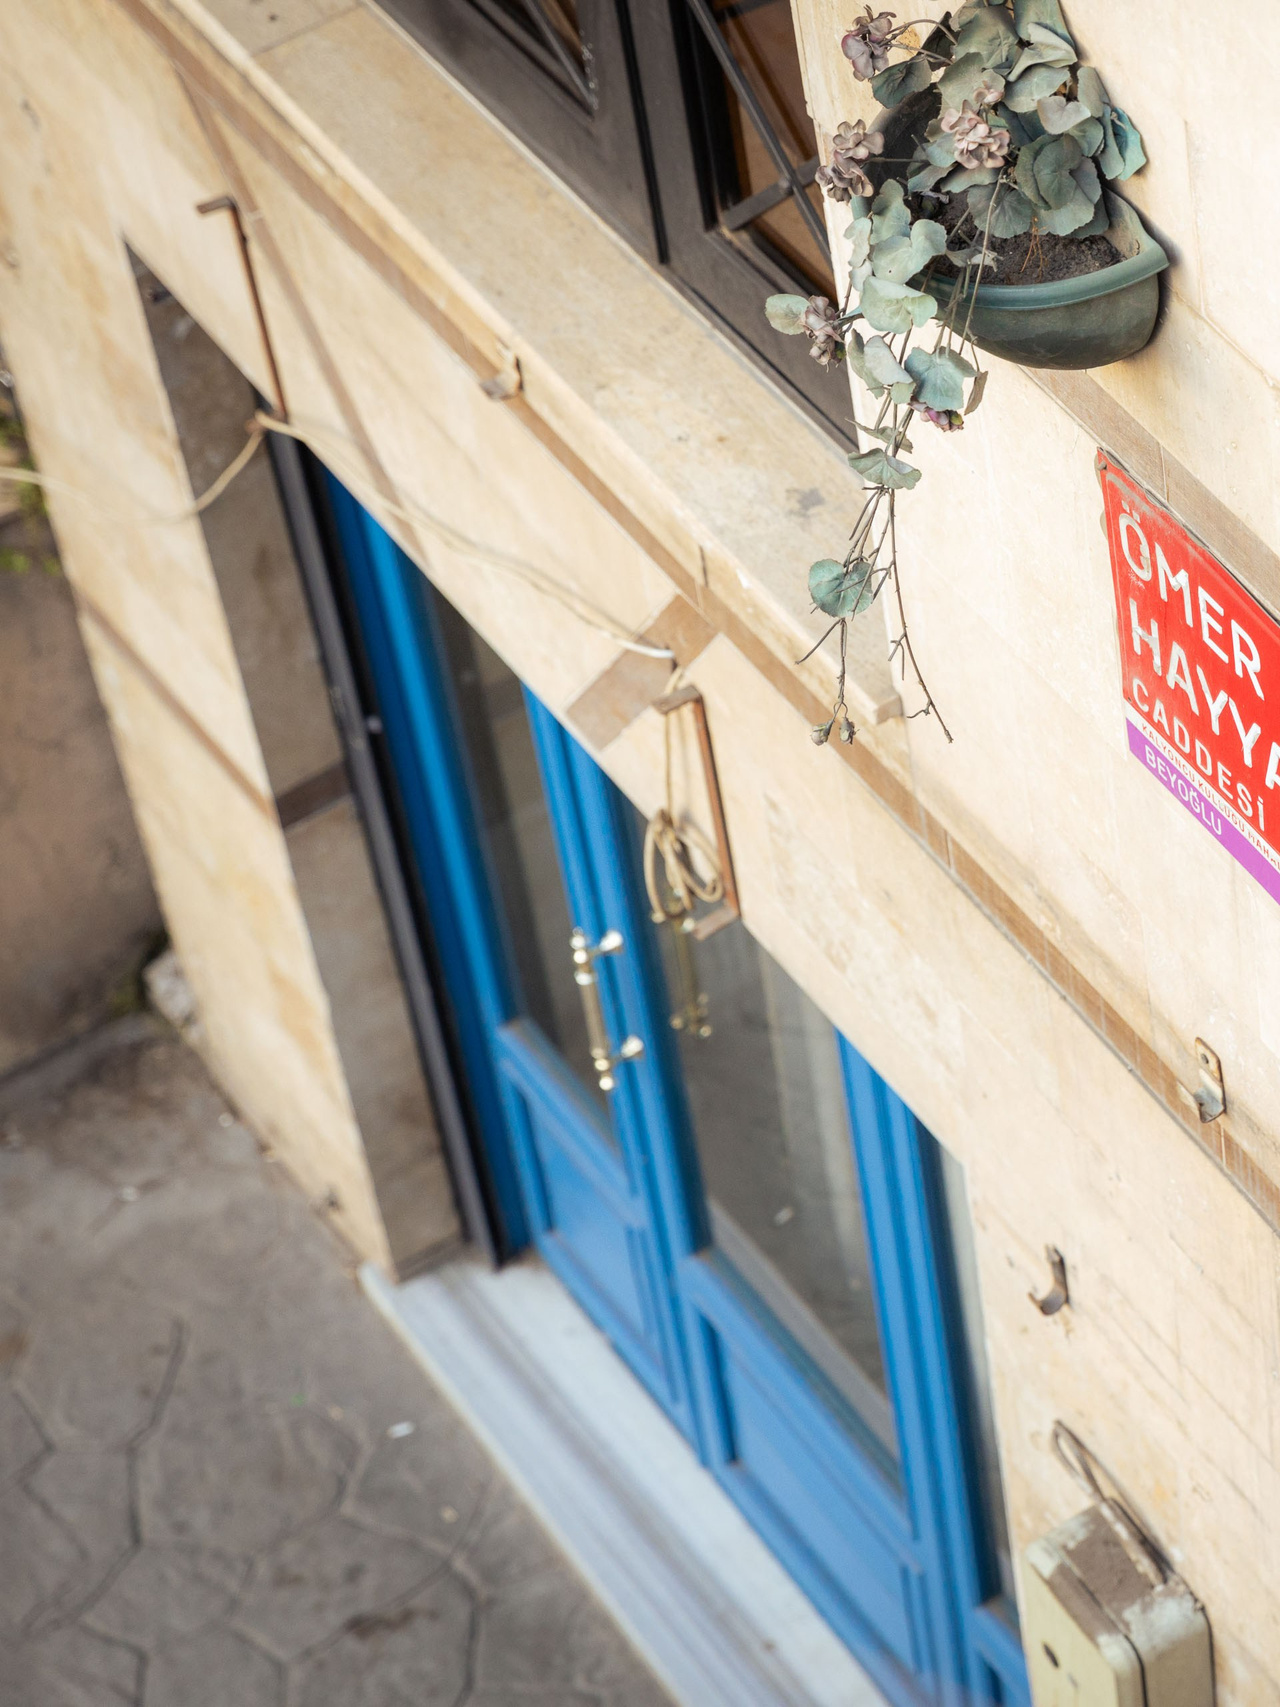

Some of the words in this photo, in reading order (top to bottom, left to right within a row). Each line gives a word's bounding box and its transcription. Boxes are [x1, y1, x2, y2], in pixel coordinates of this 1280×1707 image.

[1118, 500, 1265, 701] ÖMER
[1132, 677, 1265, 832] CADDESİ
[1142, 723, 1195, 782] KALYONCU
[1145, 744, 1222, 836] BEYOĞLU
